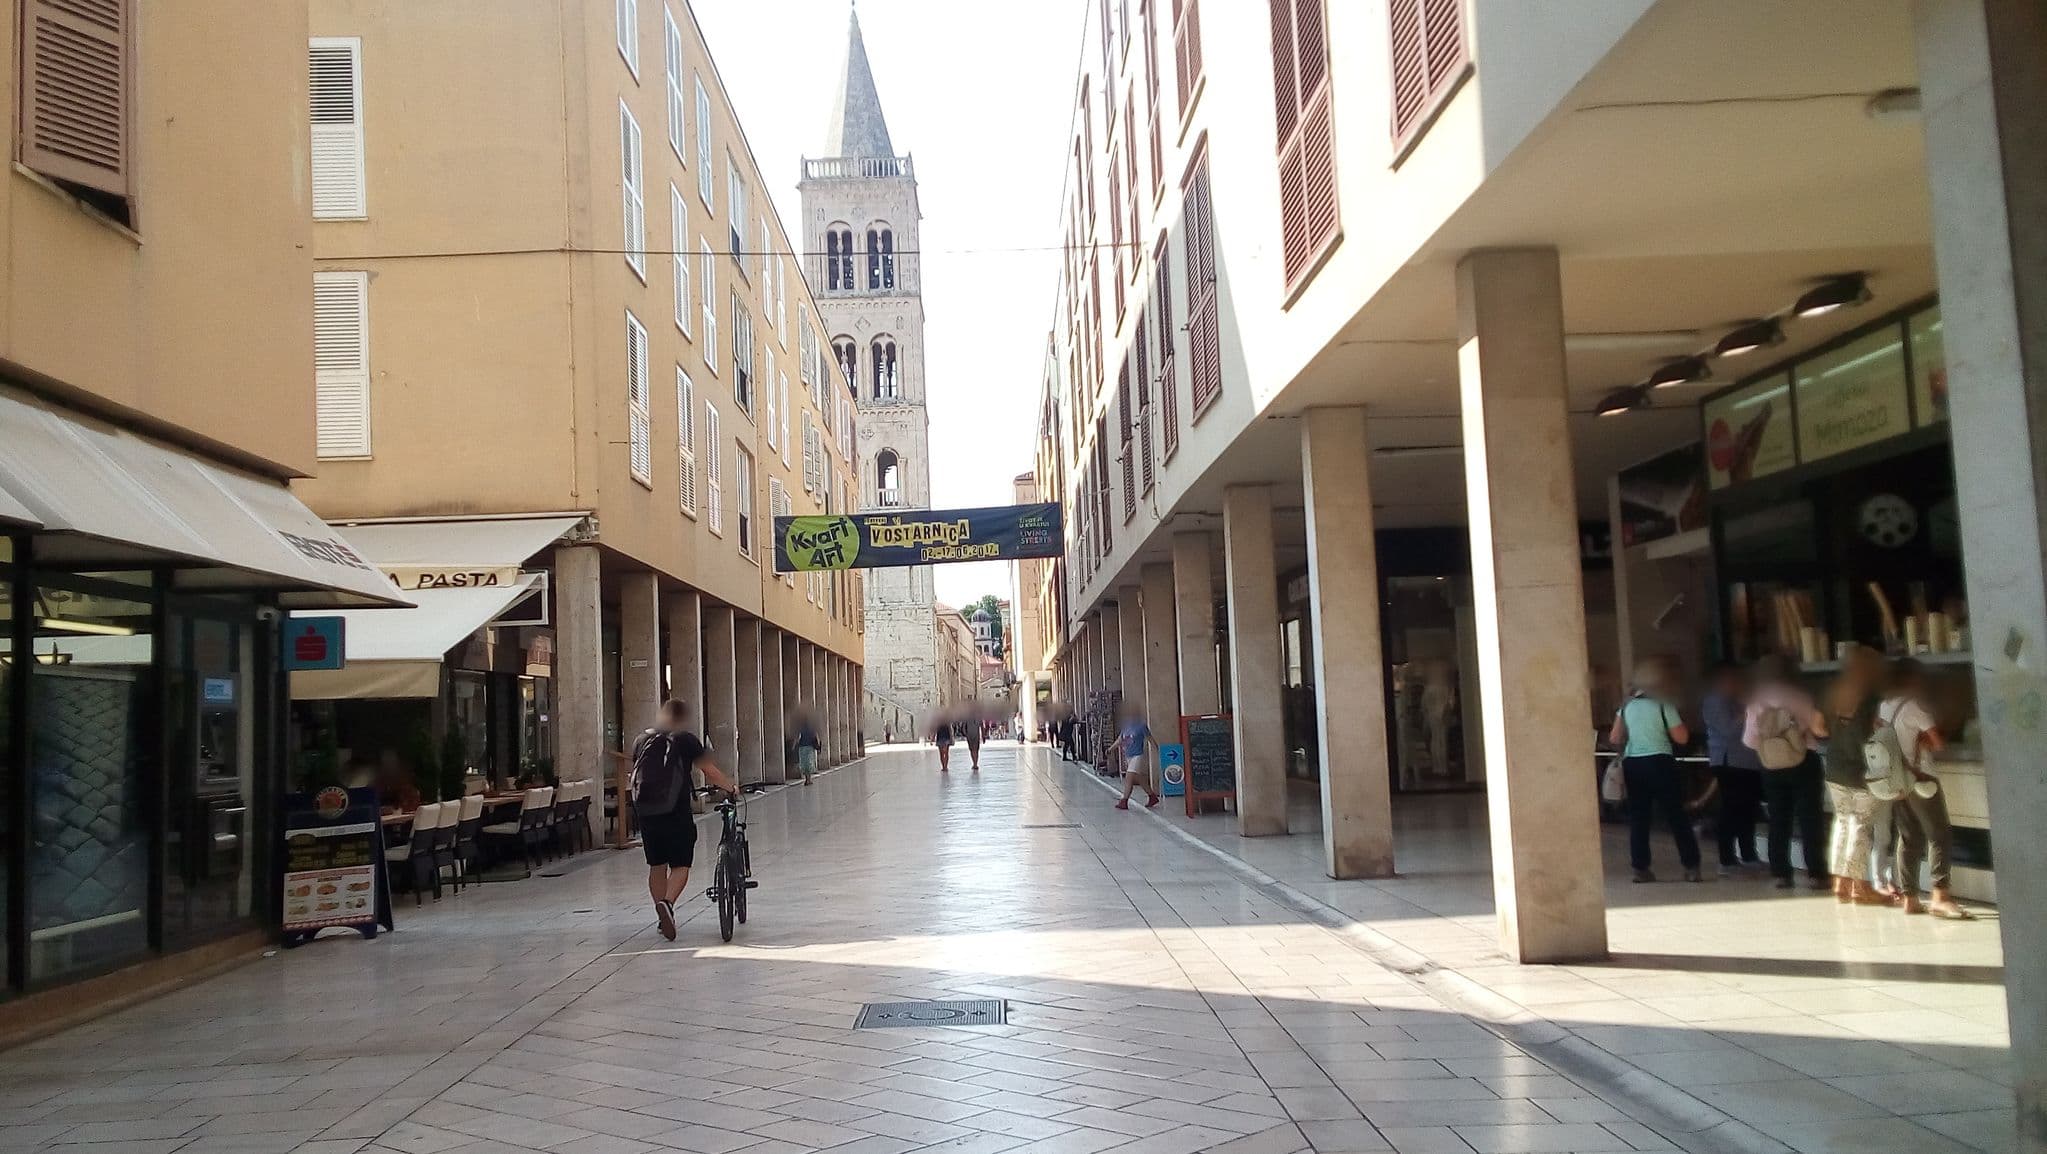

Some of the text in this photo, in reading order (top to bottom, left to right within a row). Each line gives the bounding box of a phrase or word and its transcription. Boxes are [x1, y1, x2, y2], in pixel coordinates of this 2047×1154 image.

[790, 517, 849, 552] Kvart
[872, 522, 968, 543] VOSTARNICA
[808, 541, 844, 567] Art
[417, 573, 498, 589] PASTA
